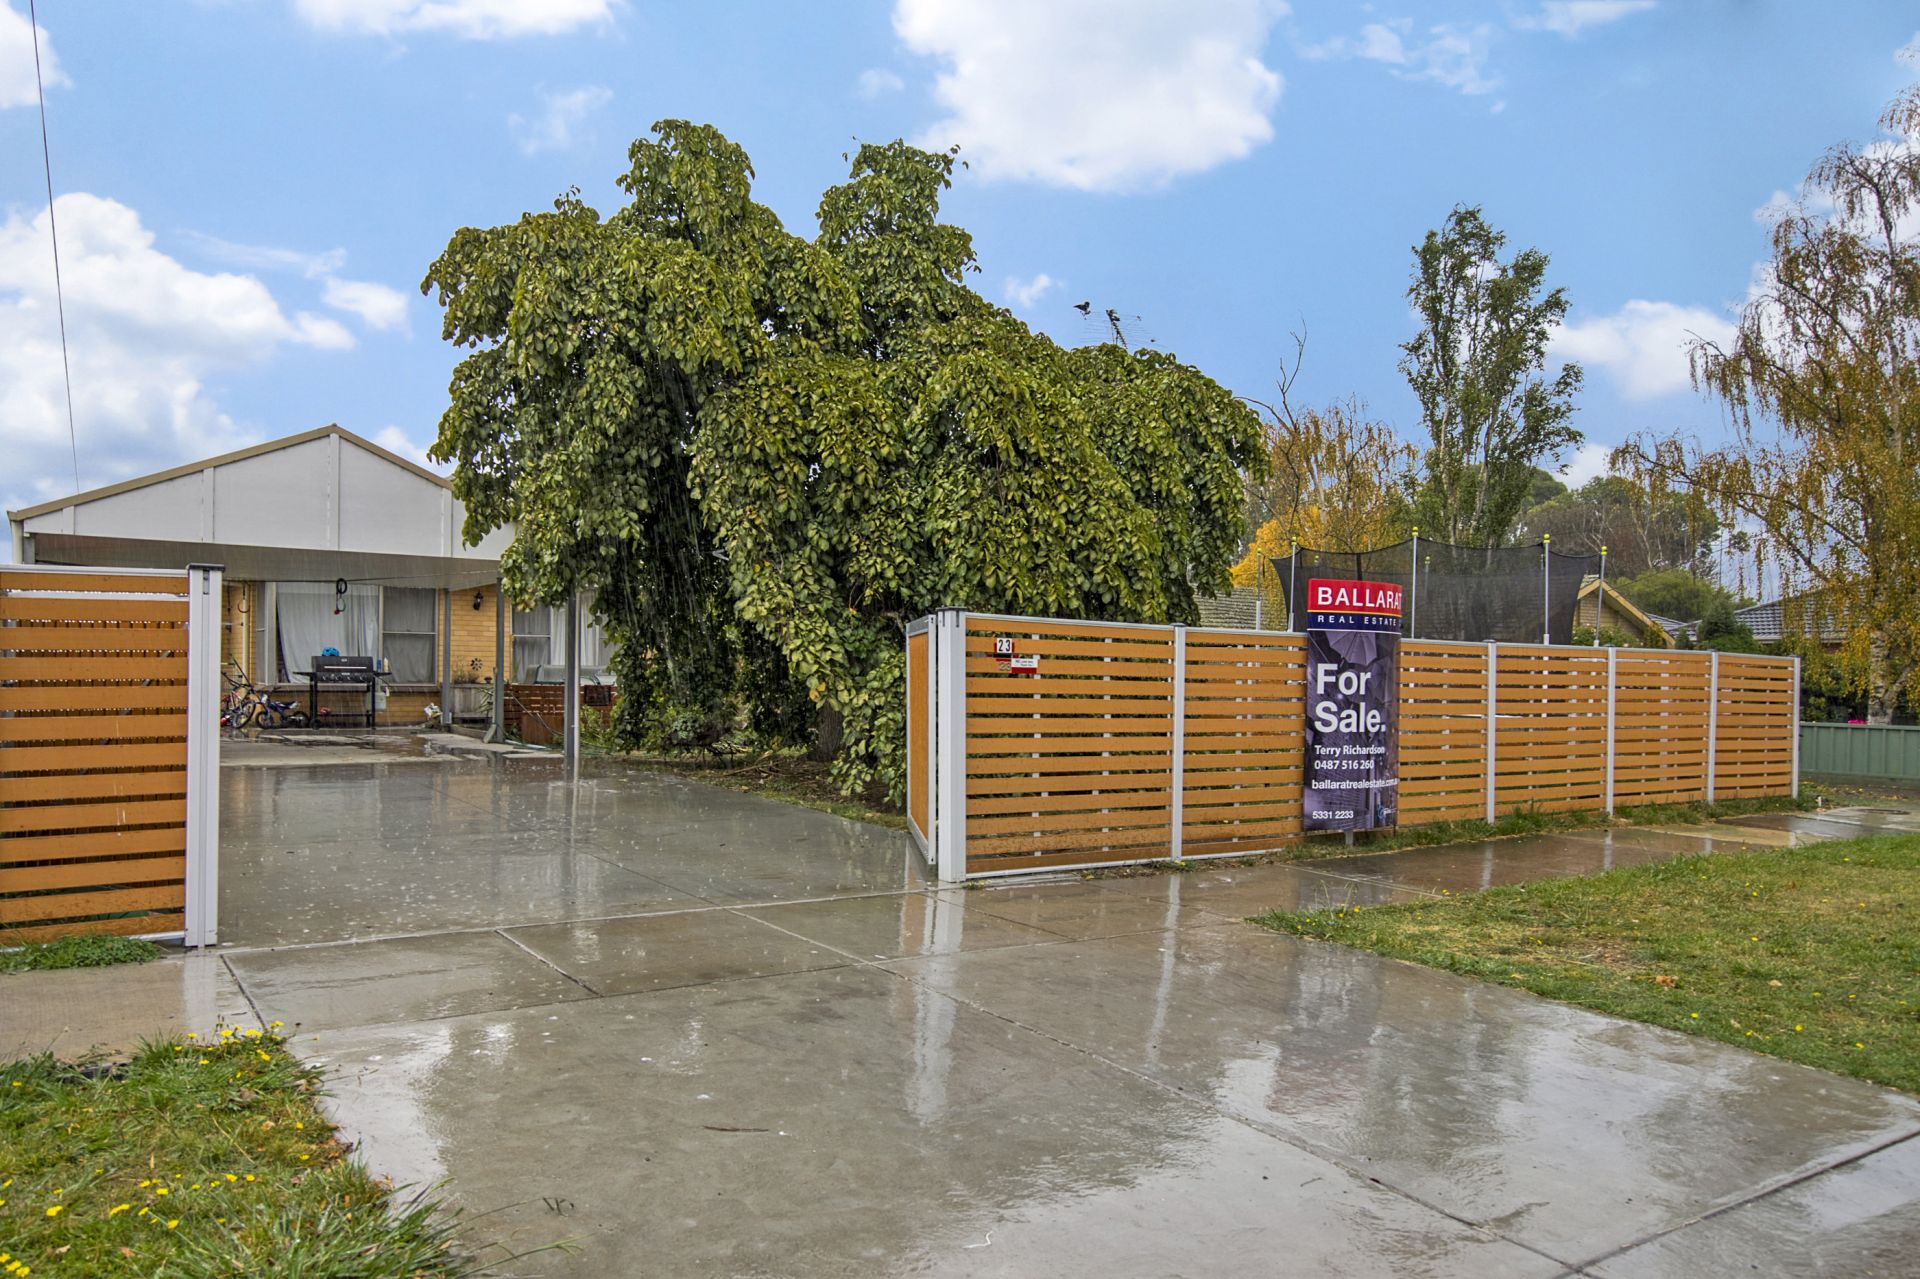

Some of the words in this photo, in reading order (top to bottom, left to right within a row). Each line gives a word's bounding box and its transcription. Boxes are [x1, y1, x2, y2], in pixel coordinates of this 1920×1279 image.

[1317, 614, 1355, 624] REAL
[1364, 616, 1397, 627] ESTATE
[998, 639, 1011, 652] 23
[1316, 663, 1372, 696] For
[1314, 700, 1387, 734] Sale.
[1314, 745, 1341, 757] Terry
[1343, 744, 1386, 755] Richardson
[1314, 760, 1339, 770] 0487
[1341, 760, 1359, 770] 516
[1360, 760, 1375, 770] 260
[1312, 810, 1333, 820] 5331
[1334, 810, 1354, 820] 2233
